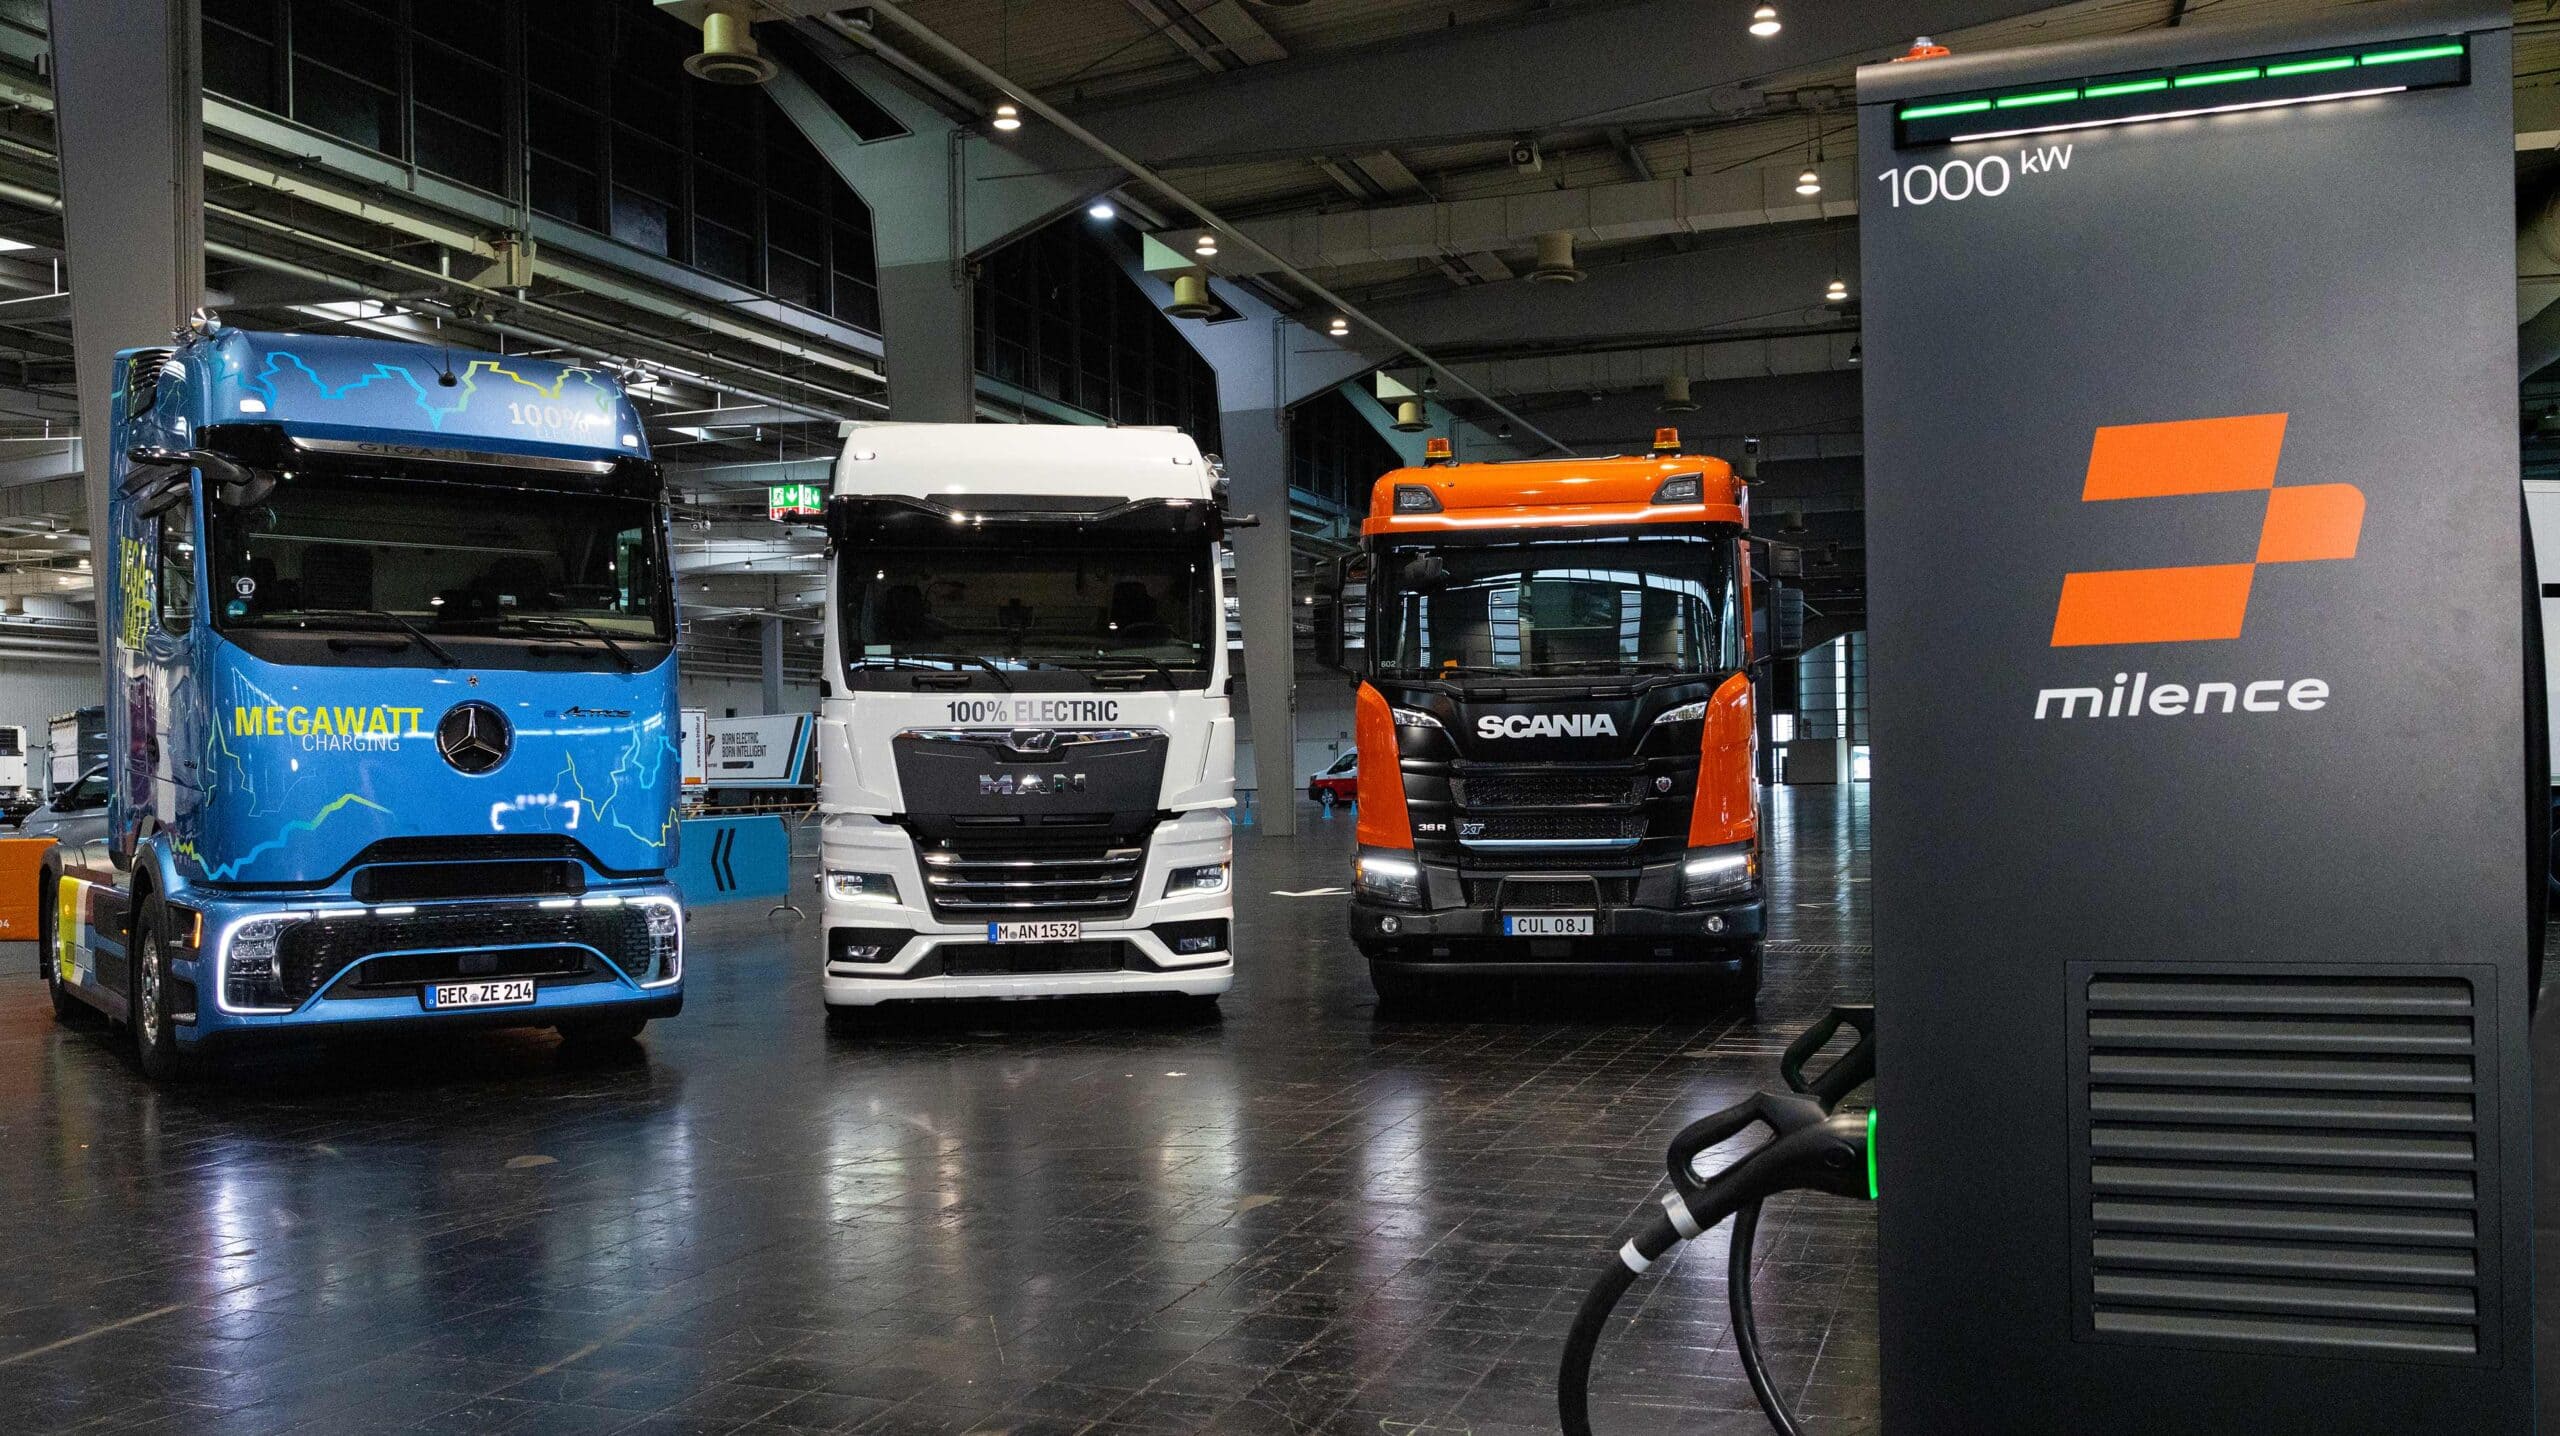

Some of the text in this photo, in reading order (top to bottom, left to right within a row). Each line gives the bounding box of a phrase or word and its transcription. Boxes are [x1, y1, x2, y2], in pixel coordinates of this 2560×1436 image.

[1878, 144, 2073, 208] 1000 kW
[508, 403, 589, 433] 100%
[1380, 660, 1396, 668] 602
[2034, 672, 2329, 719] milence
[235, 706, 424, 736] MEGAWATT
[947, 700, 1118, 722] 100% ELECTRIC
[1477, 713, 1619, 739] SCANIA
[302, 733, 400, 752] CHARGING
[722, 731, 759, 744] BORN ELECTRIC
[722, 745, 767, 758] BORN INTELLIGENT
[979, 773, 1086, 795] MAN
[1418, 823, 1446, 831] 36 R
[1460, 823, 1485, 834] XT
[998, 923, 1077, 939] M AN 1532
[1518, 918, 1586, 933] CUL 08J
[438, 983, 532, 1004] GER ZE 214
